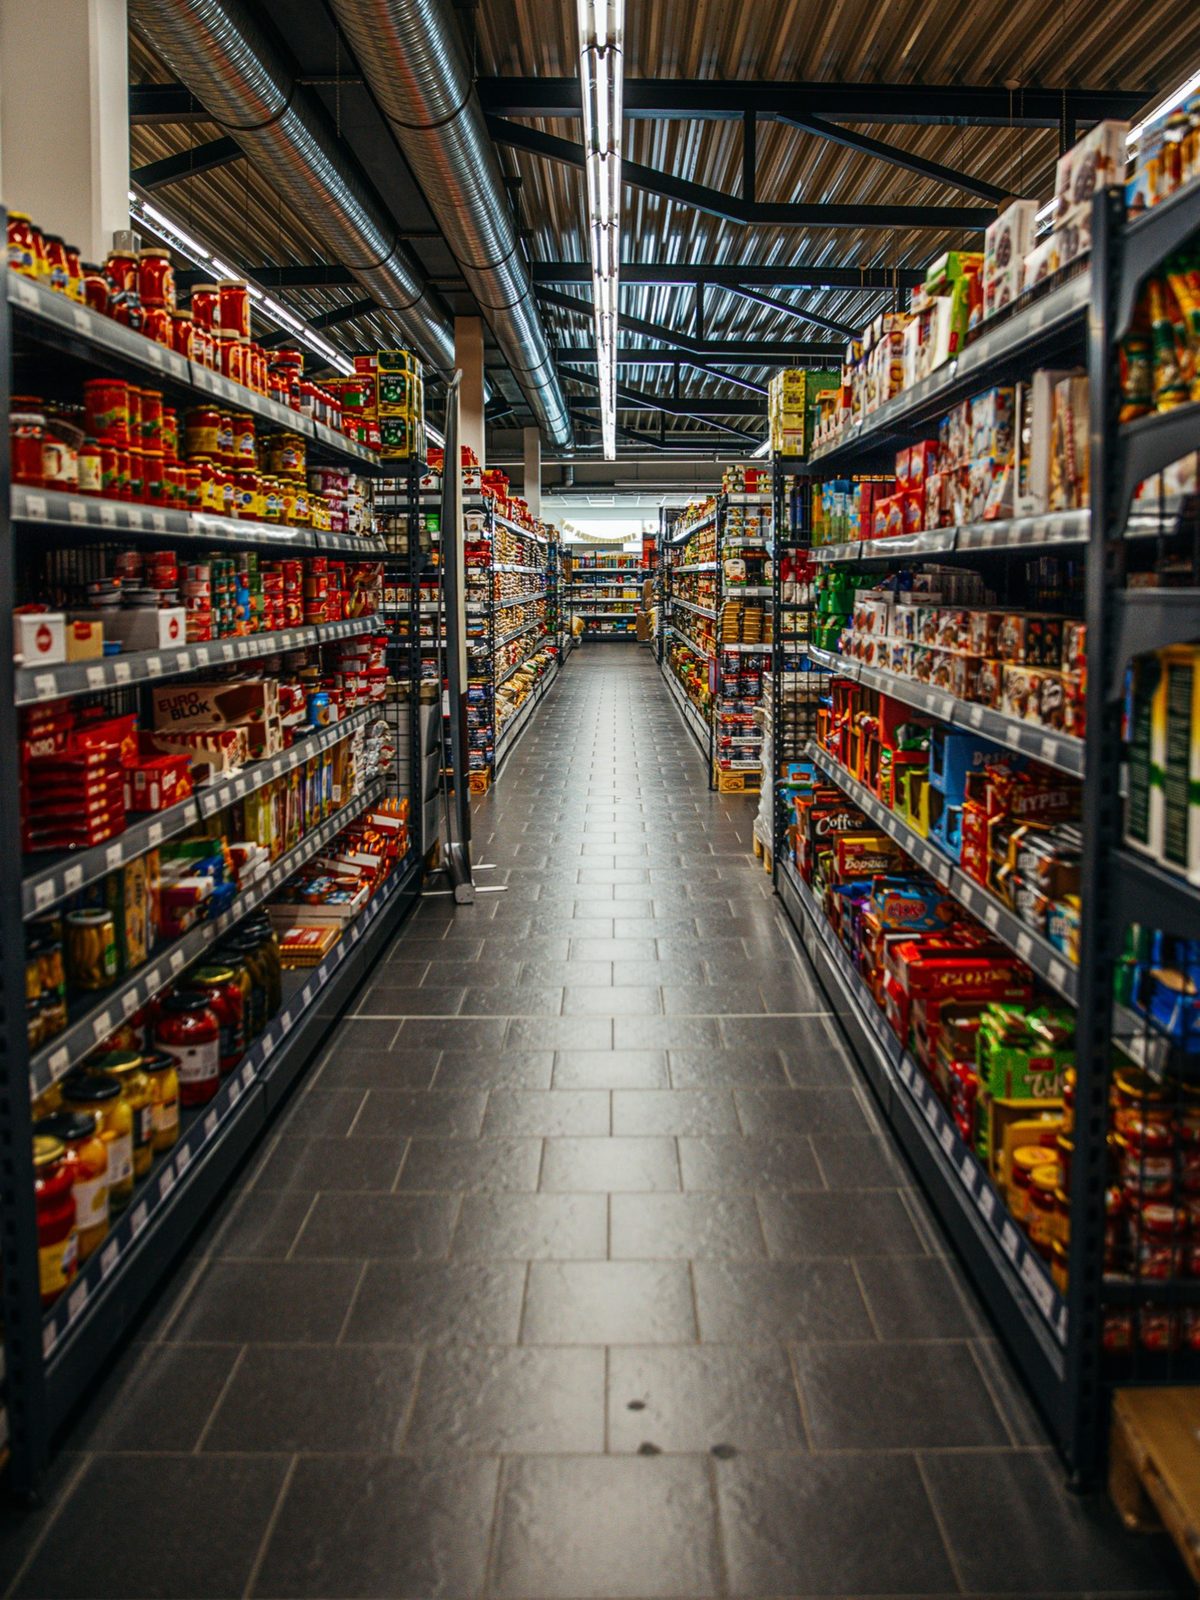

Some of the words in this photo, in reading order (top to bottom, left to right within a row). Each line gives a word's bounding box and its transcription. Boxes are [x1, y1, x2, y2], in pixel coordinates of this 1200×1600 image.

[158, 692, 199, 712] EURO
[170, 700, 211, 721] BLOK
[1018, 791, 1069, 813] HYPER
[815, 813, 863, 836] Coffee
